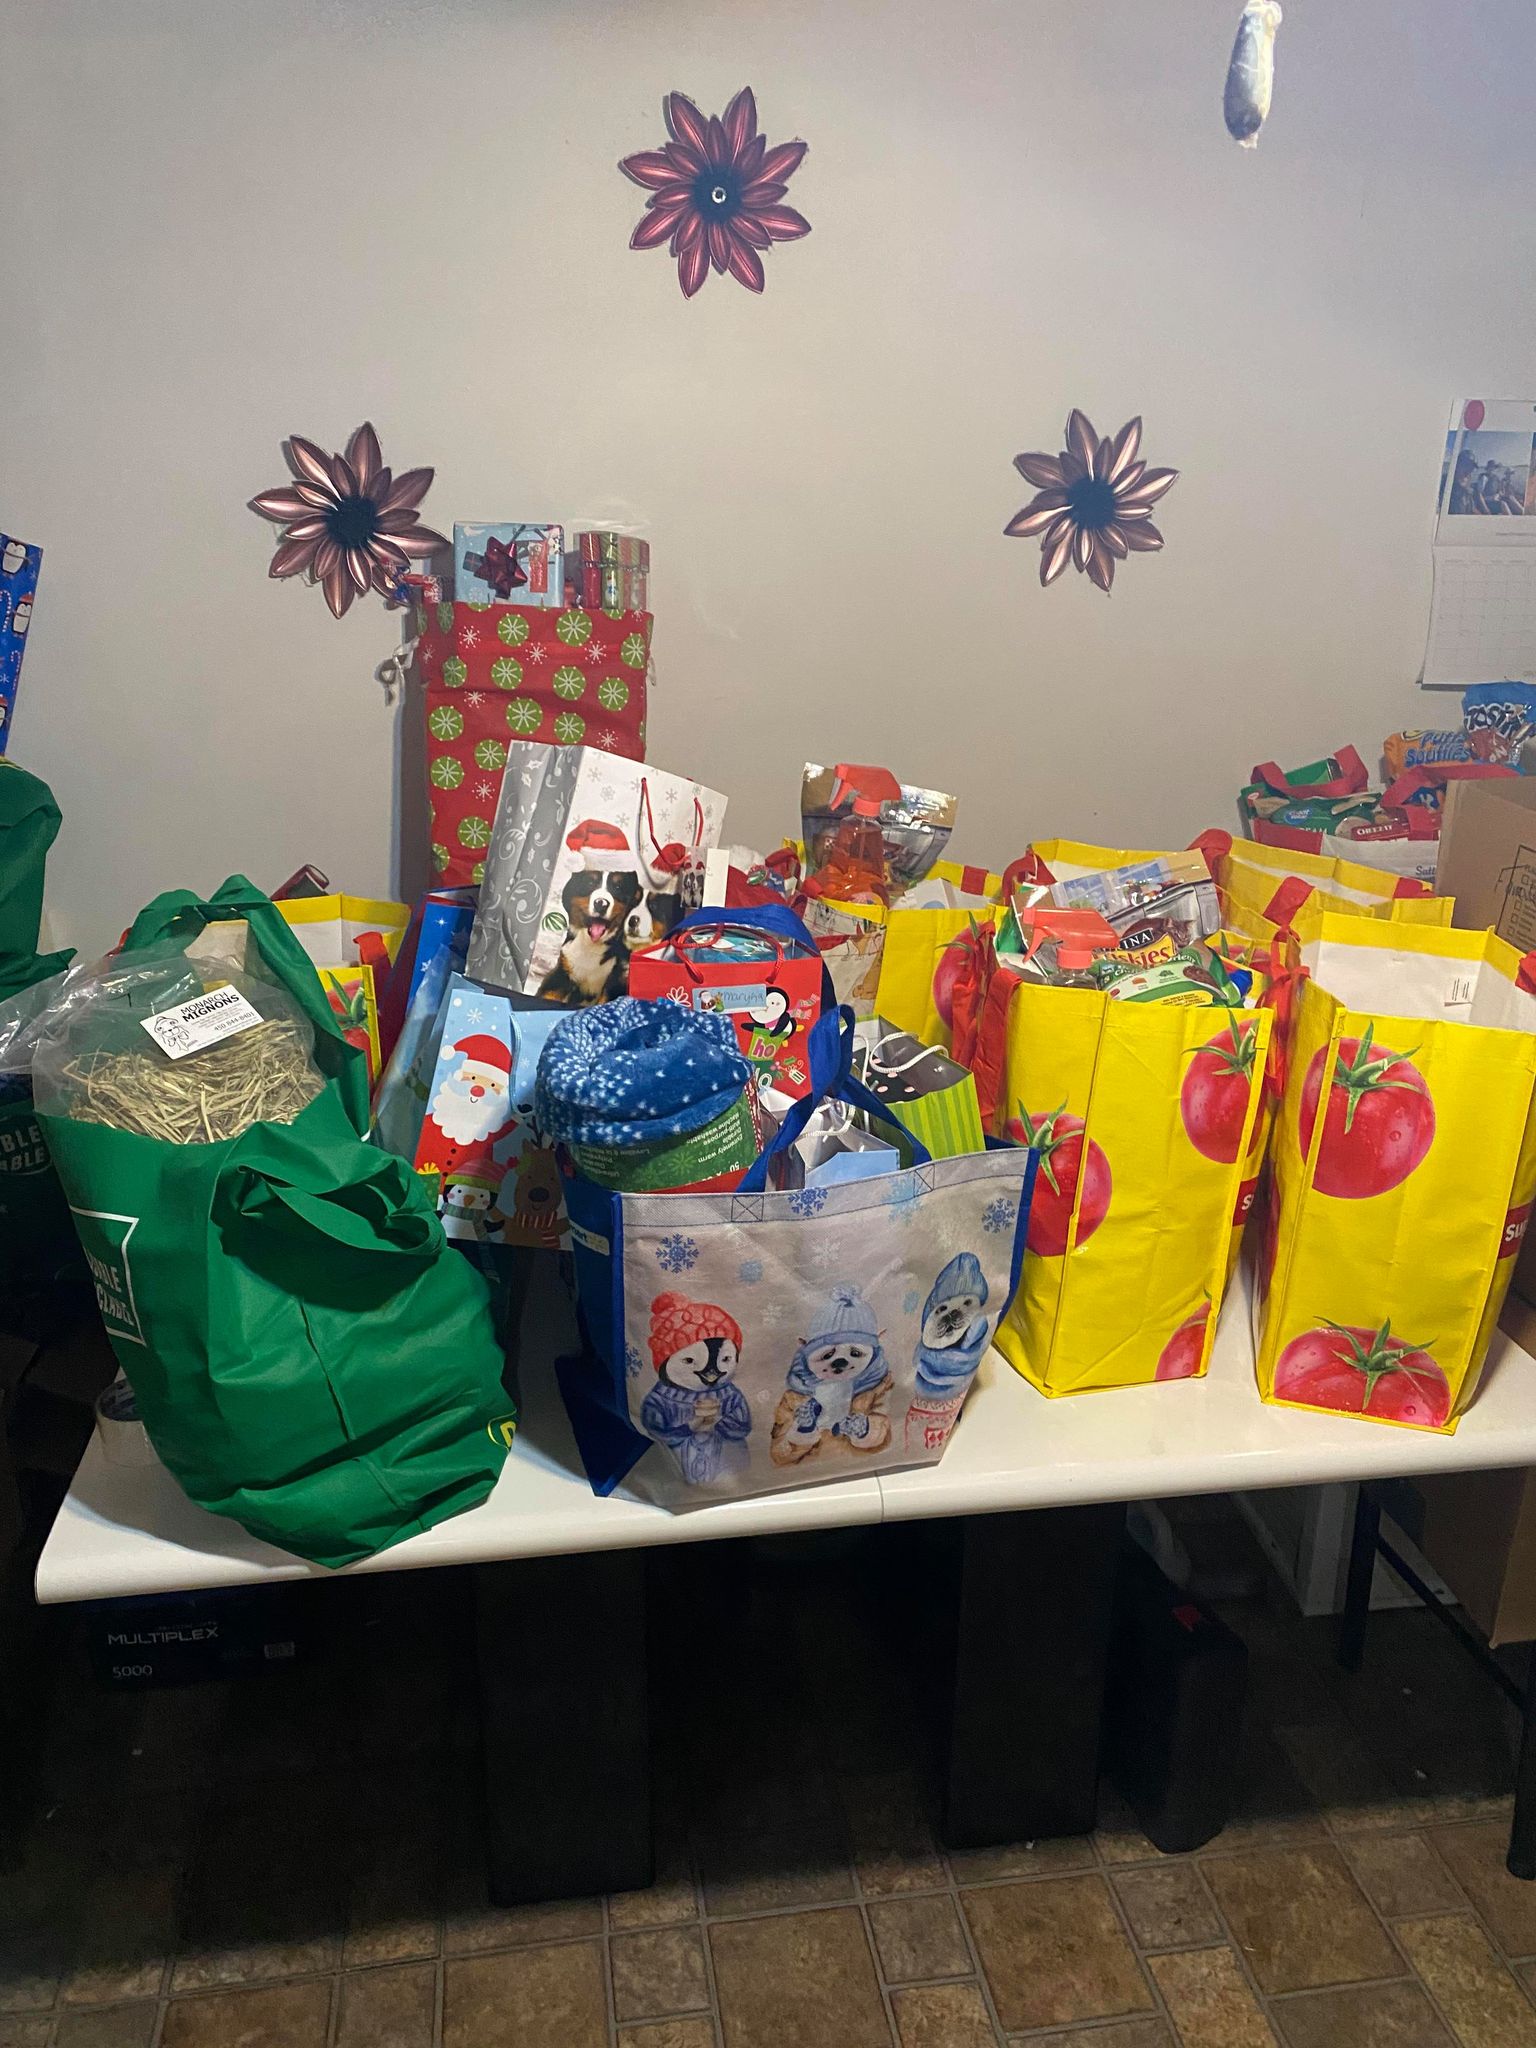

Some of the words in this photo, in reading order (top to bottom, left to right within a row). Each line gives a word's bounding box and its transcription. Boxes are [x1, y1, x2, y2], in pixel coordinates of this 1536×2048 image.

[1121, 932, 1152, 950] INA
[180, 992, 228, 1015] MONARCH
[182, 995, 239, 1022] MIGNONS
[752, 1036, 776, 1058] ho
[698, 1151, 717, 1163] warm
[108, 1626, 219, 1645] MULTIPLEX
[112, 1664, 153, 1679] 5000
